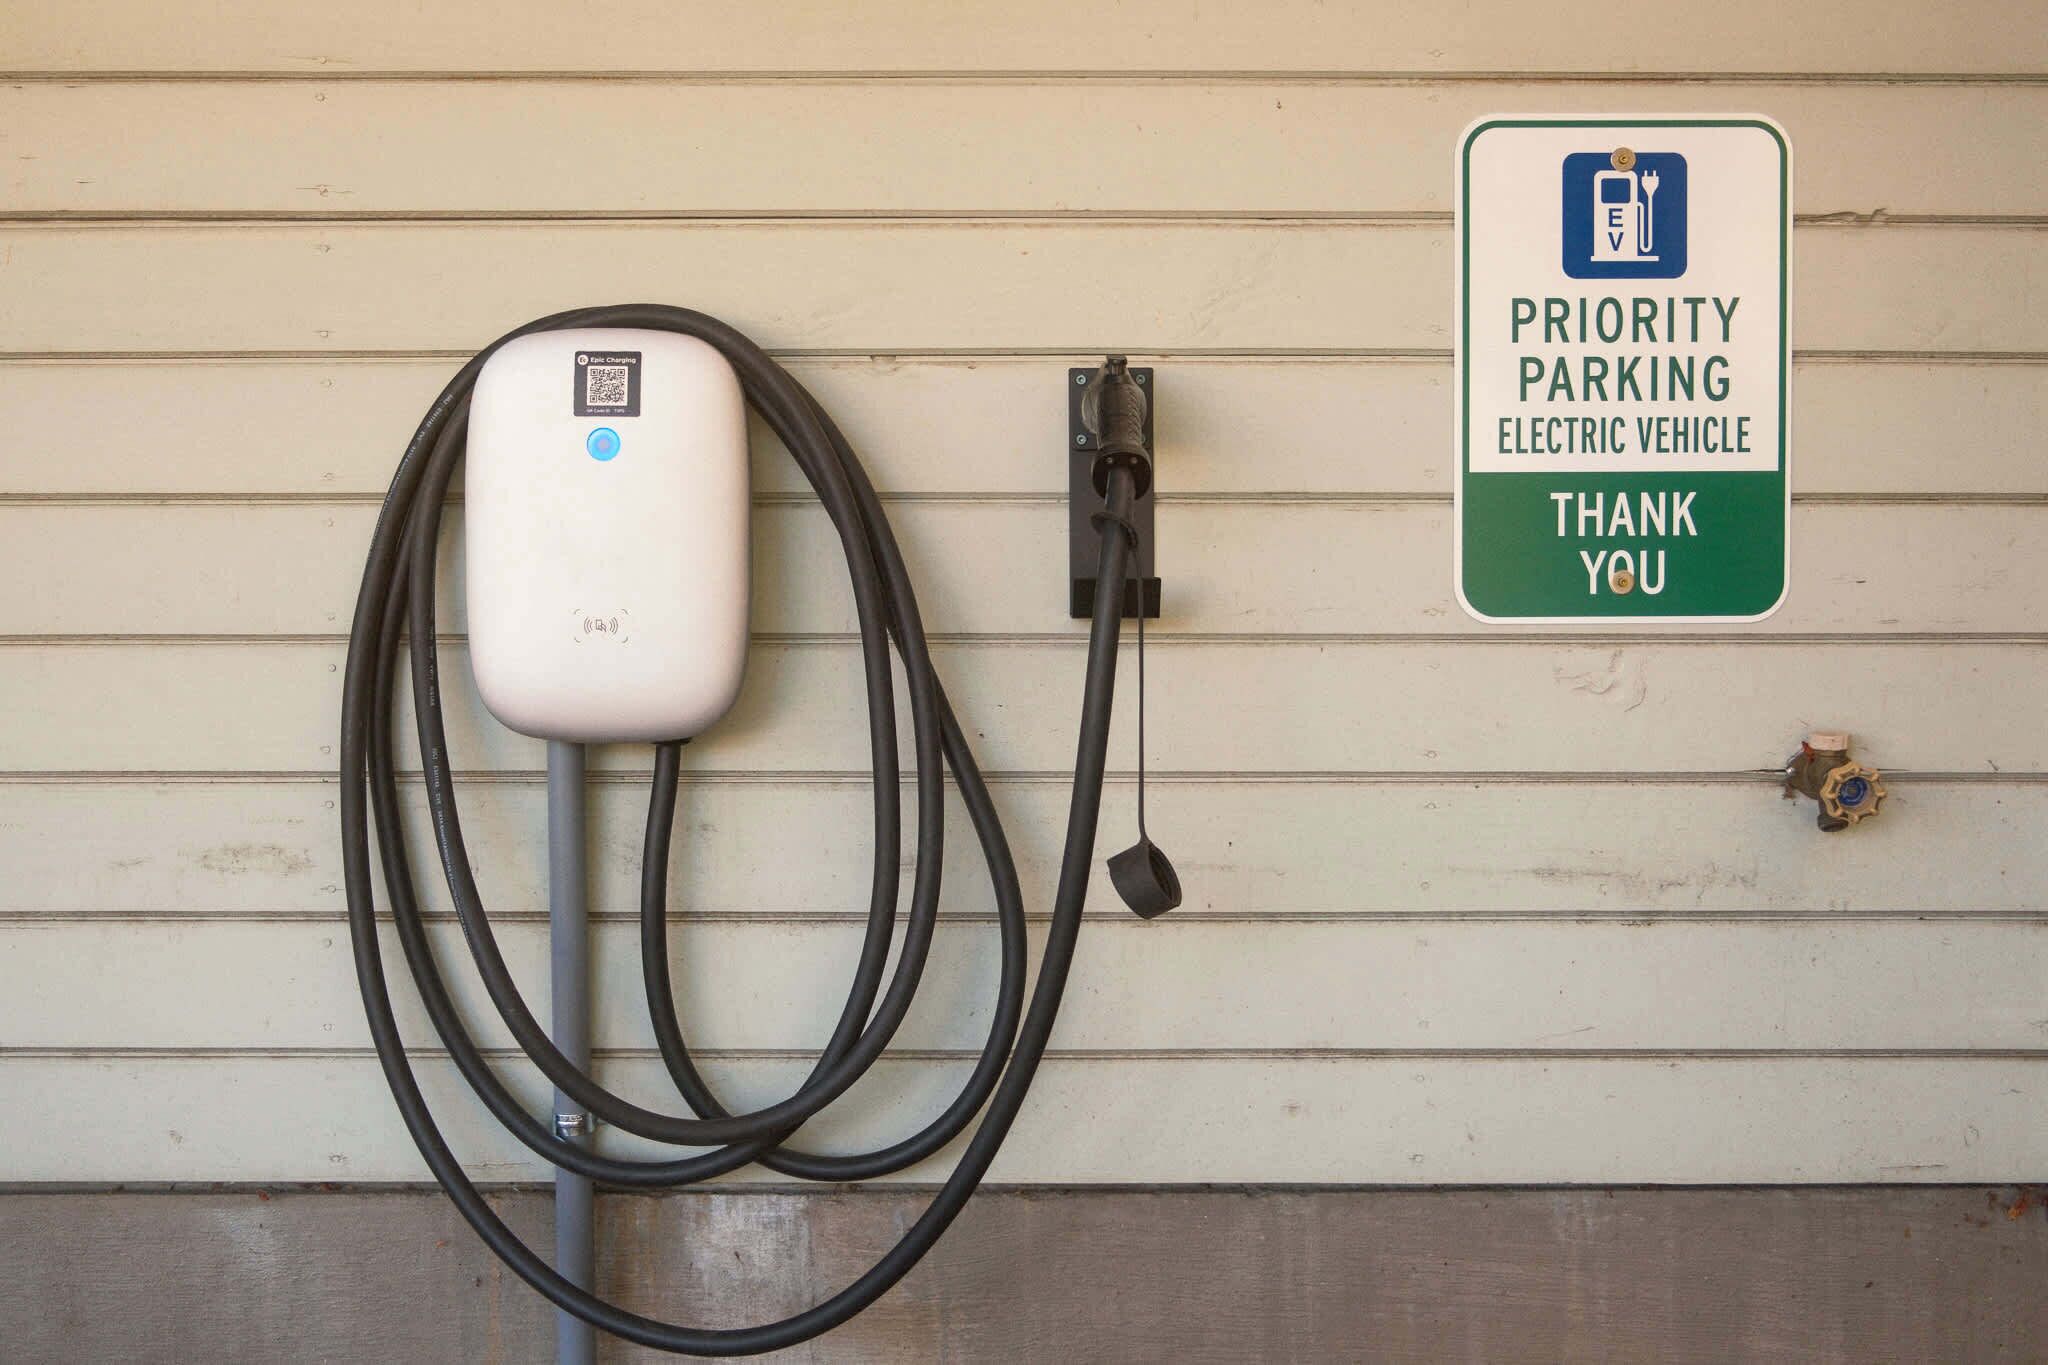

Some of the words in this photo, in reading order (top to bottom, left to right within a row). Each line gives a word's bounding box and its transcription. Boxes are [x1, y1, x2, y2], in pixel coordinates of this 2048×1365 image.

[1608, 208, 1623, 228] E
[1608, 231, 1624, 251] V
[1511, 296, 1740, 344] PRIORITY
[1519, 355, 1730, 402] PARKING
[1498, 416, 1626, 455] ELECTRIC
[1636, 415, 1751, 454] VEHICLE
[1550, 491, 1697, 537] THANK
[1579, 549, 1665, 595] YOU
